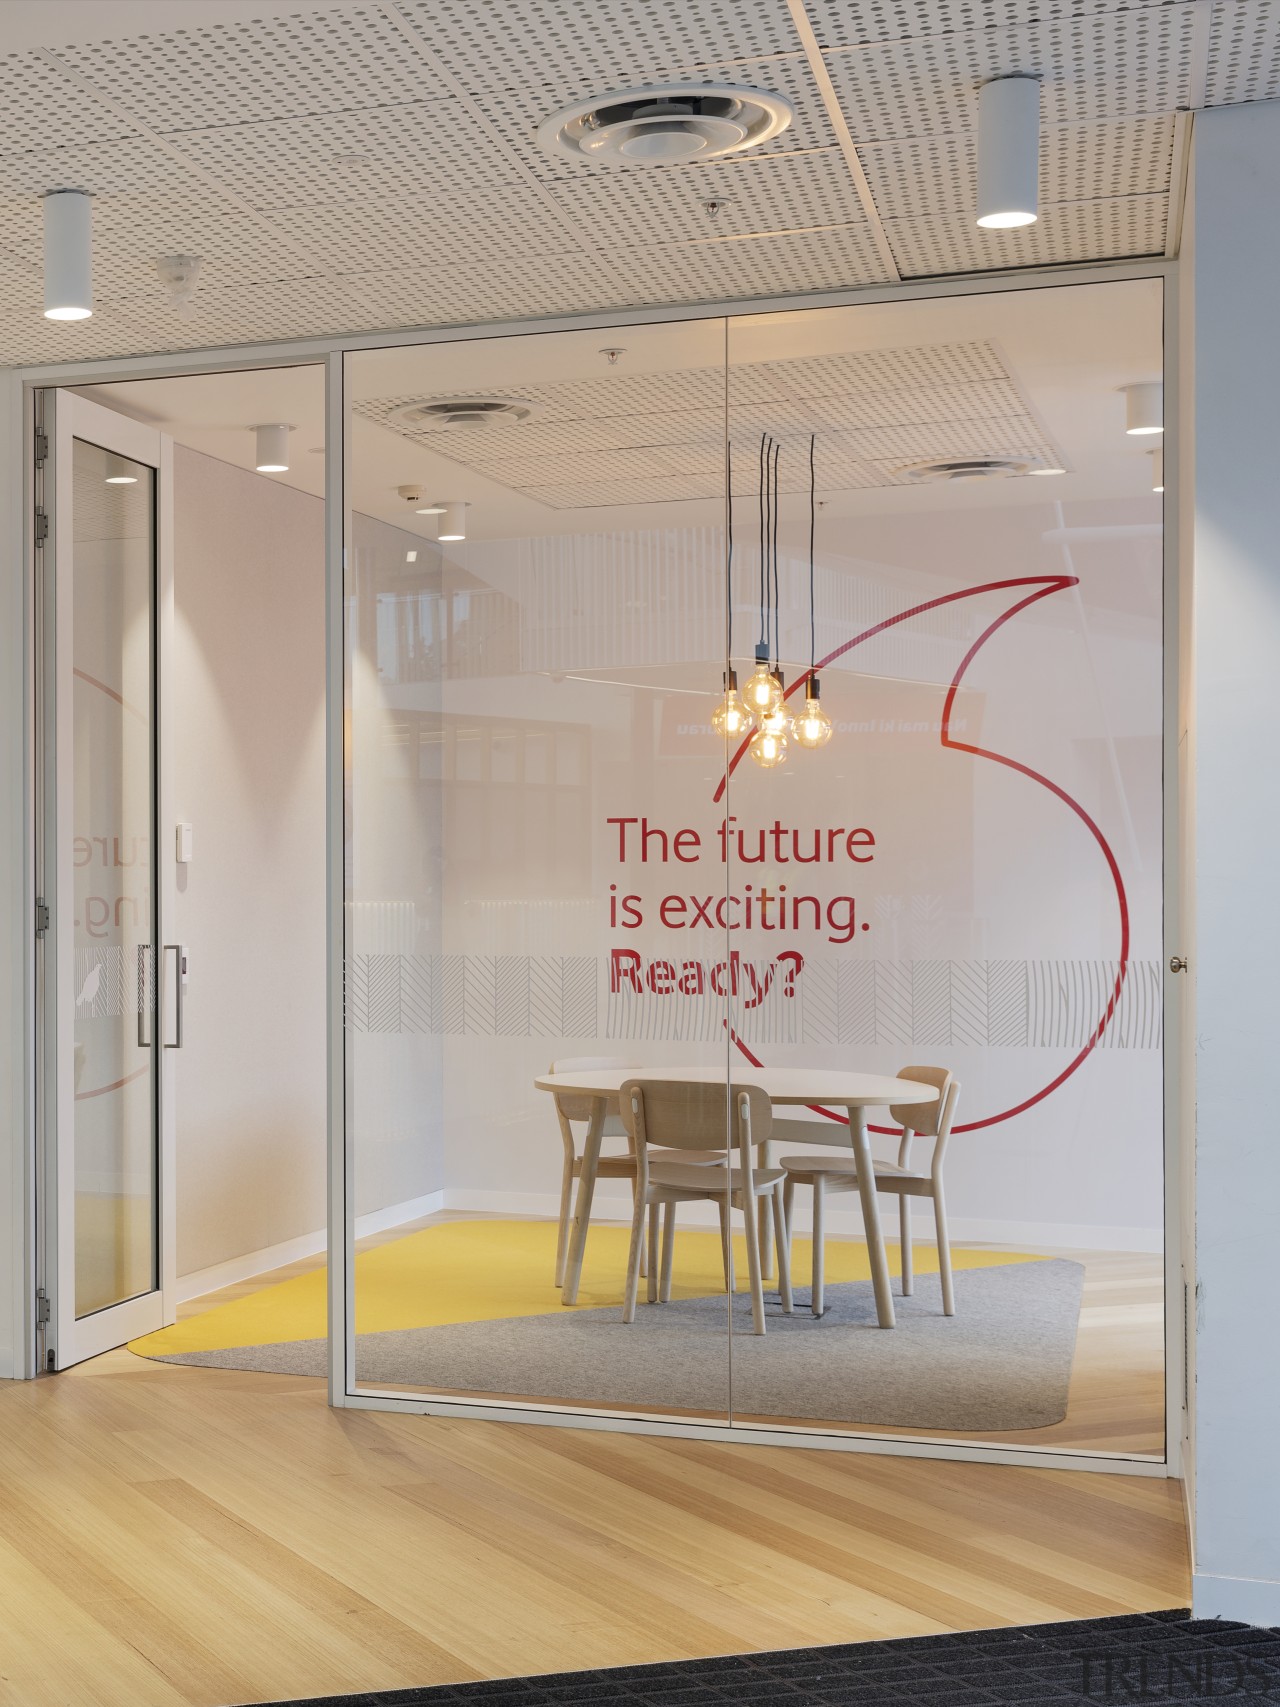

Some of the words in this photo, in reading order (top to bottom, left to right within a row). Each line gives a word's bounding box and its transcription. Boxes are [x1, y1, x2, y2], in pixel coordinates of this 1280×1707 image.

[606, 817, 701, 863] The
[717, 816, 876, 863] future
[609, 884, 643, 929] is
[659, 884, 870, 944] exciting.
[610, 949, 805, 1009] Ready?
